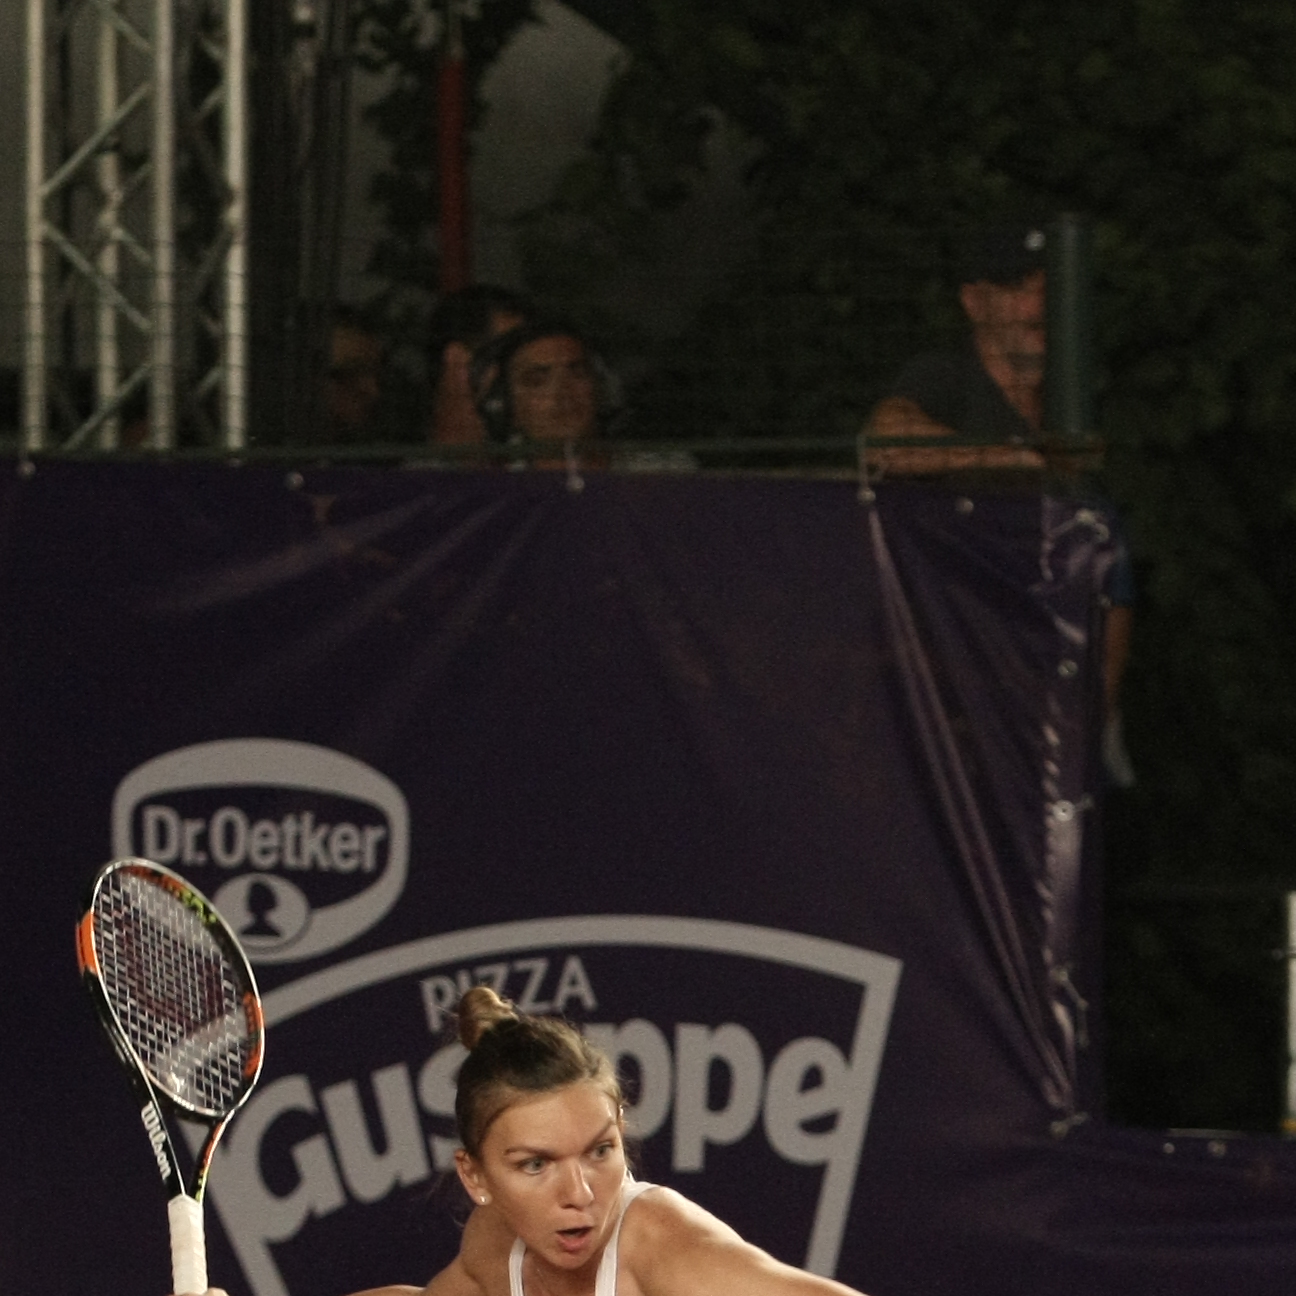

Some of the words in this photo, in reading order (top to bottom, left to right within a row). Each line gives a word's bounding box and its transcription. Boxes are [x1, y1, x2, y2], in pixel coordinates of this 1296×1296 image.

[141, 804, 387, 873] Dr.Oetker
[140, 1100, 172, 1182] Wilson
[226, 1015, 852, 1244] Gusppe
